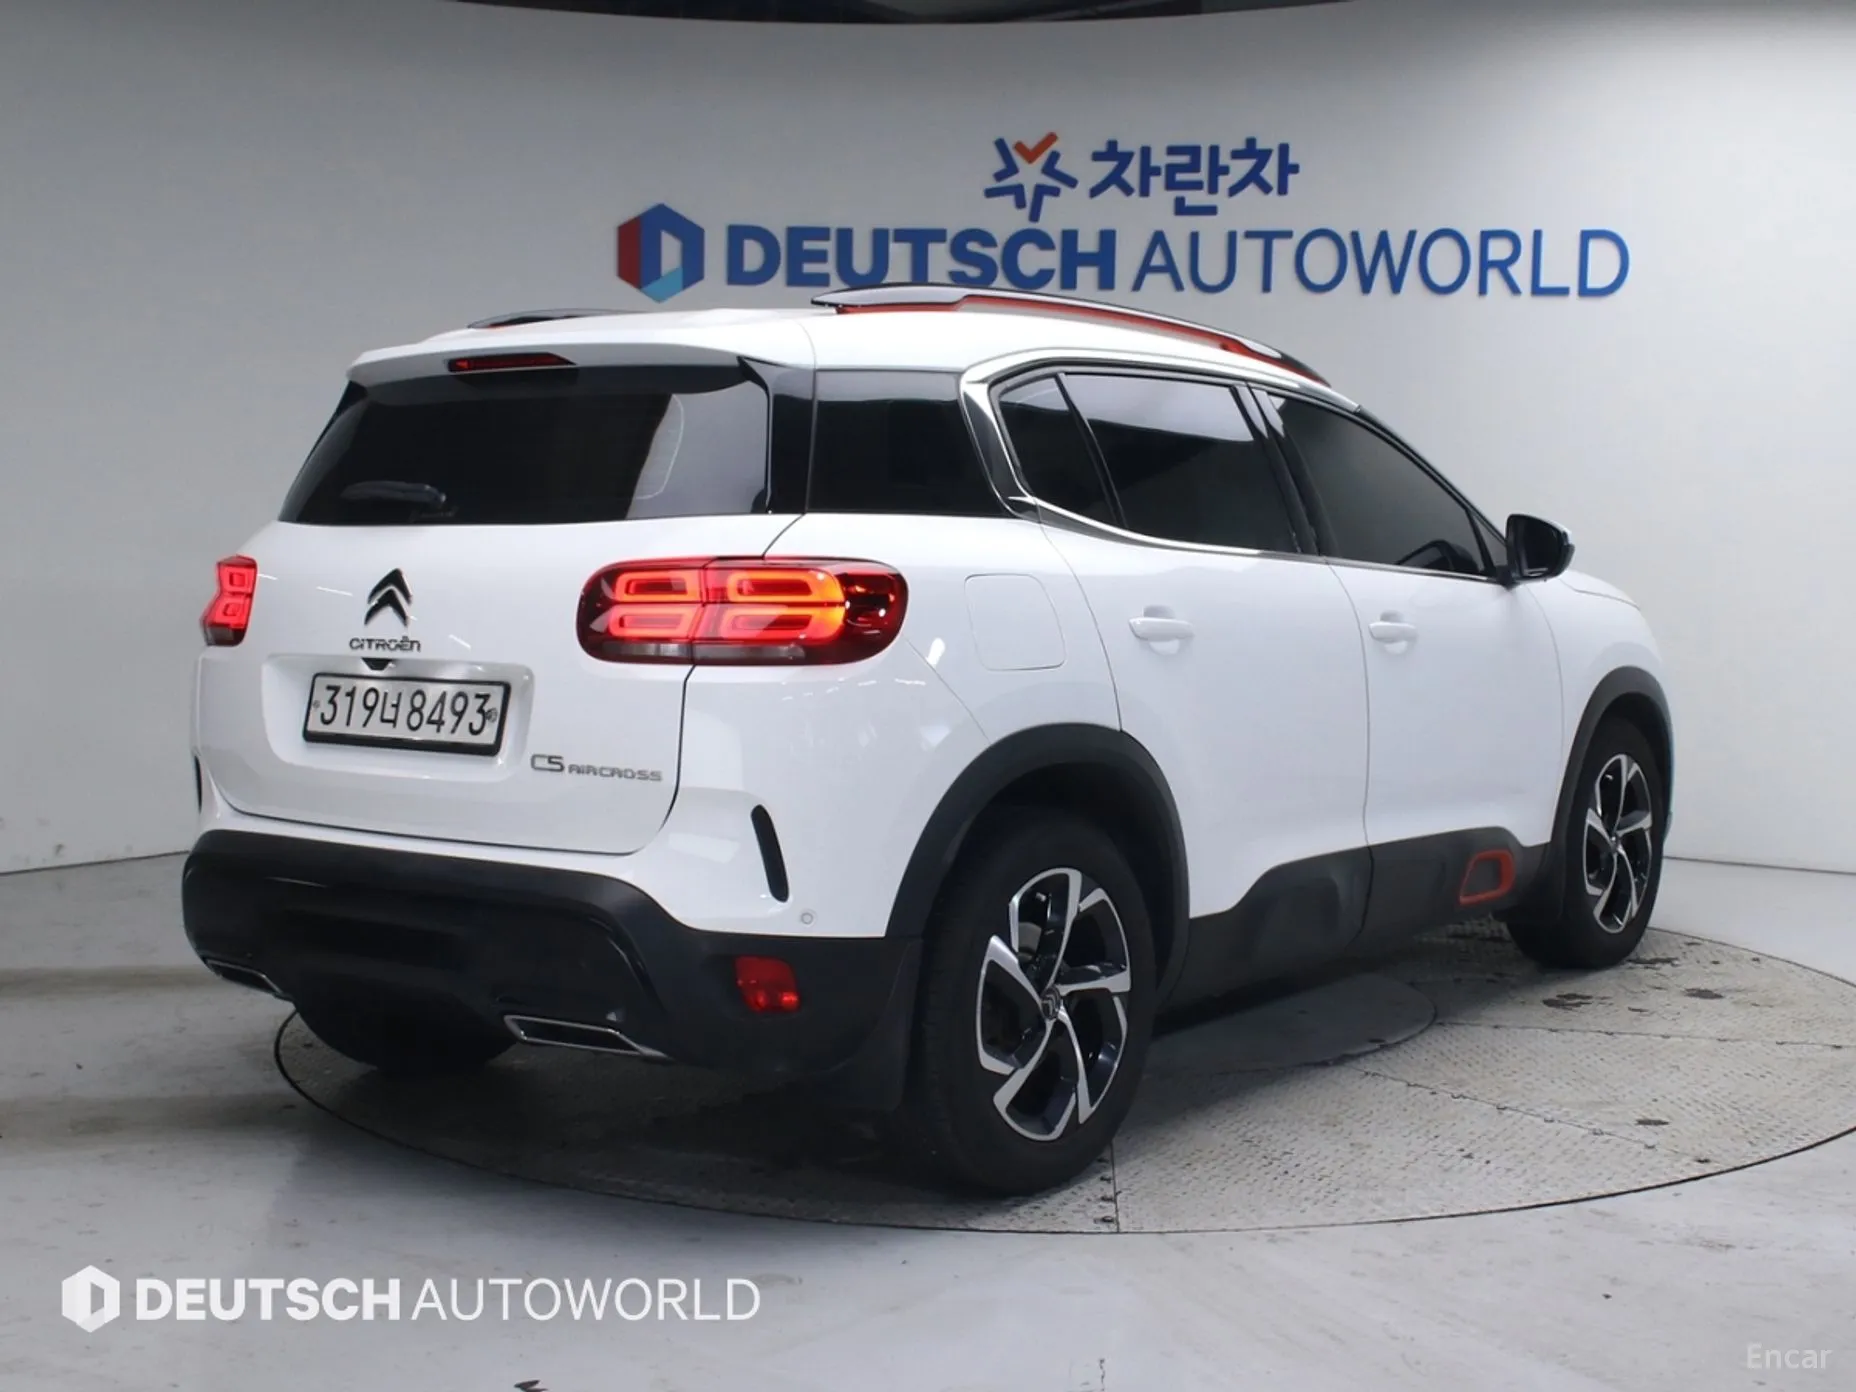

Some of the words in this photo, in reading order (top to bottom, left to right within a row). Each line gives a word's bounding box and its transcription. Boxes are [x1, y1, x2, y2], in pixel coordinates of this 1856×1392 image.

[1089, 137, 1300, 216] 차란차
[726, 224, 1117, 291] DEUTSCH
[1131, 227, 1630, 297] AUTOWORLD
[530, 754, 565, 773] C5
[568, 764, 663, 782] AIRCROSS
